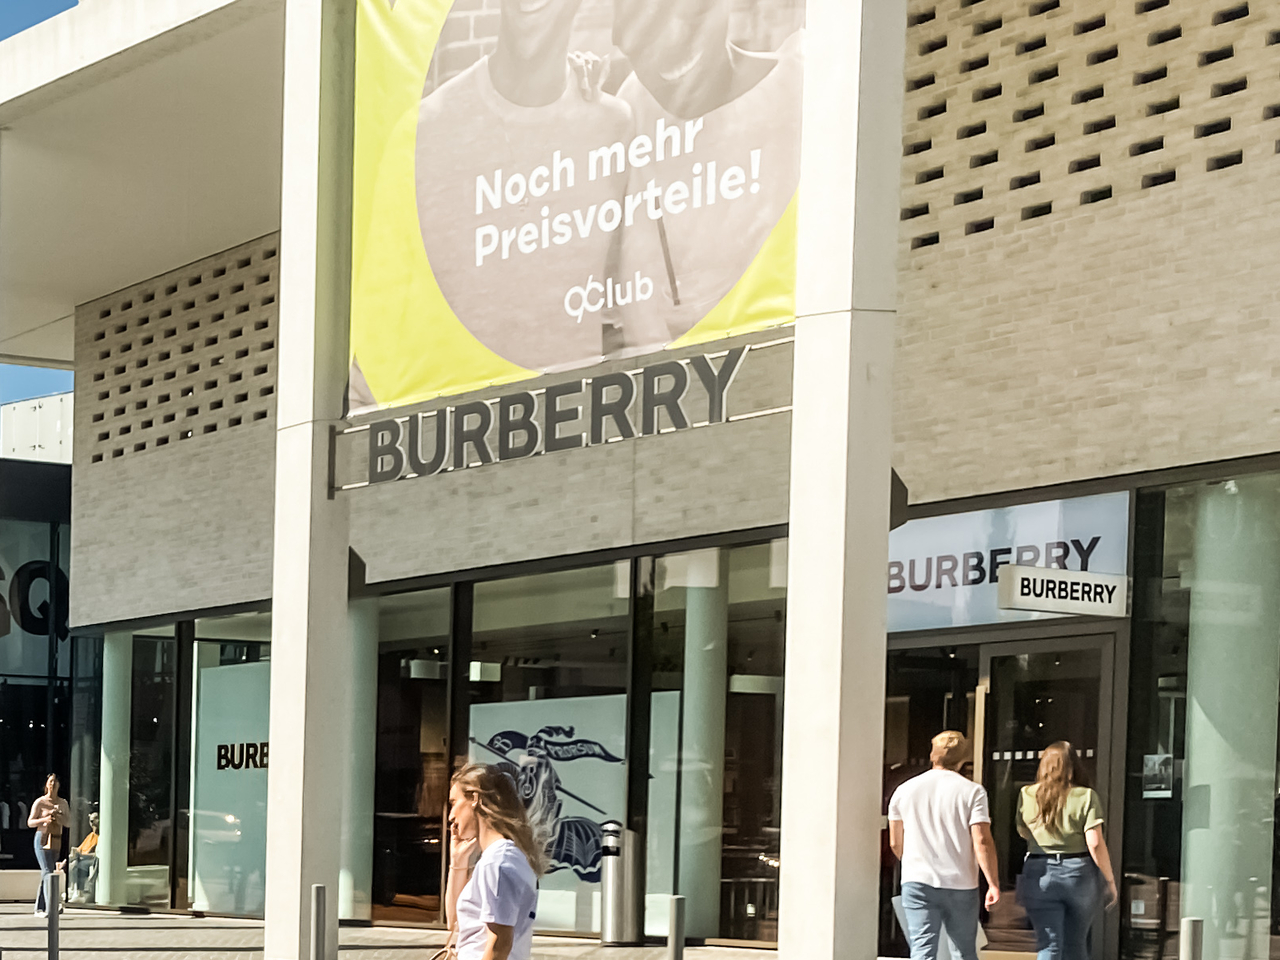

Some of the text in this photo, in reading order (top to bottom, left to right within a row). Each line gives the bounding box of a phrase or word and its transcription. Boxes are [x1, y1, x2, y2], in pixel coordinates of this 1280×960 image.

[474, 148, 762, 267] Preisvorteile!
[475, 116, 704, 216] Noch mehr
[369, 345, 751, 484] BURBERRY
[1020, 576, 1118, 605] BURBERRY
